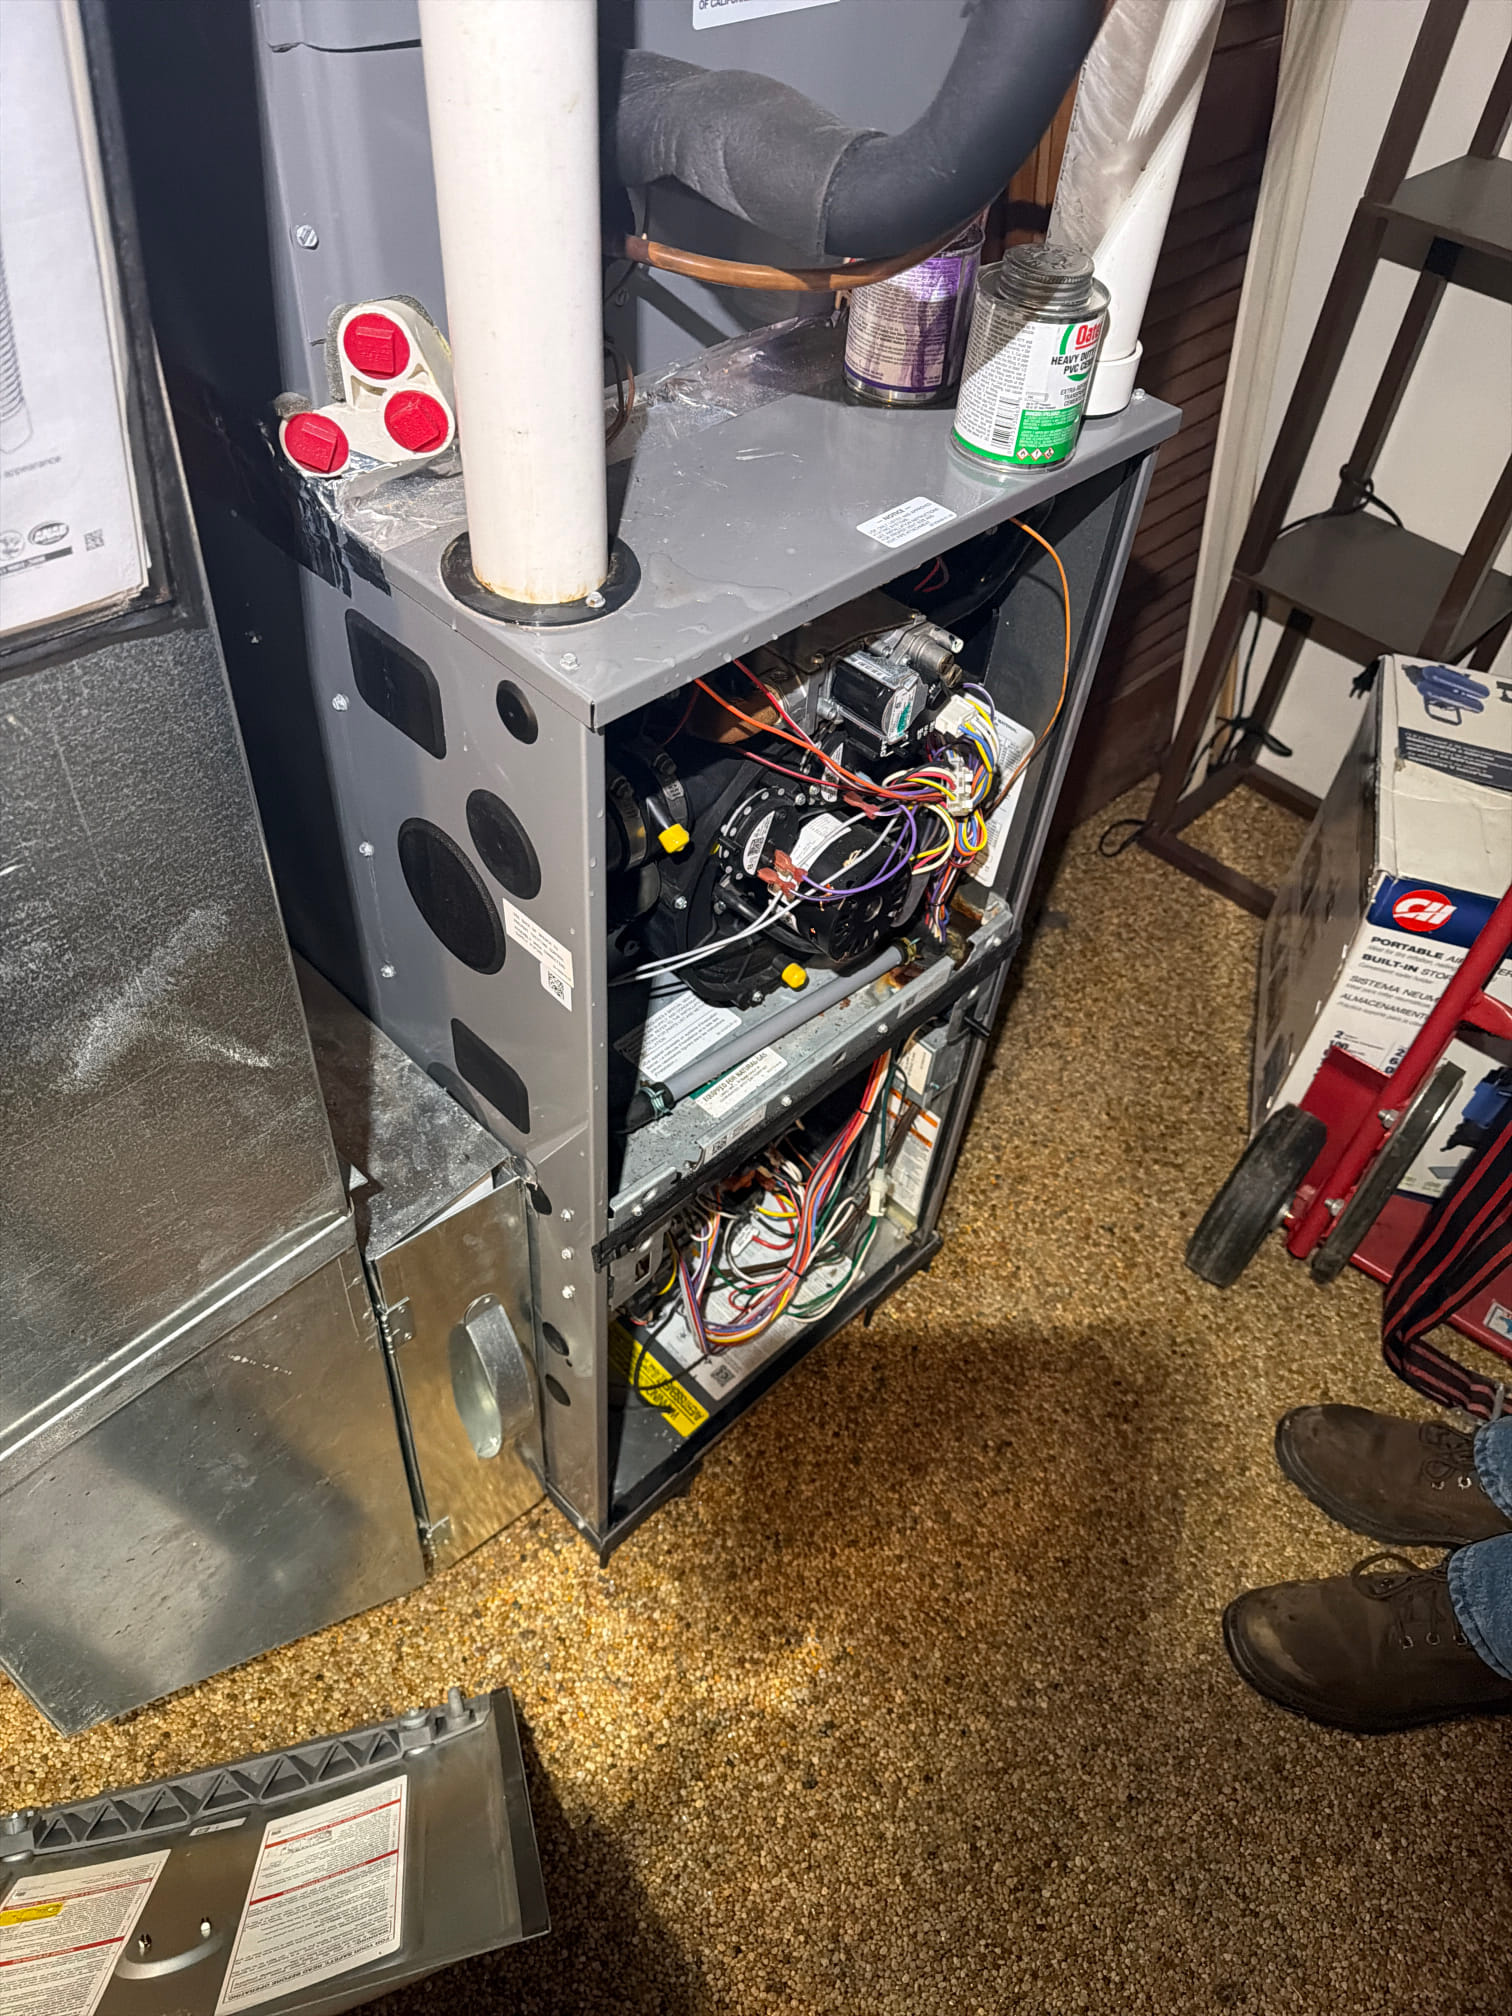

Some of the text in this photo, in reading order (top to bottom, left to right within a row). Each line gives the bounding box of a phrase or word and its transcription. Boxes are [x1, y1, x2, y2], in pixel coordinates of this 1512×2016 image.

[699, 0, 751, 10] OF CALIF
[1076, 321, 1102, 345] Oate
[1051, 354, 1080, 366] HEAVY
[1063, 364, 1079, 375] PVC
[1371, 936, 1445, 960] PORTABLE
[1362, 953, 1455, 980] BUILT-IN STOR
[1350, 975, 1400, 993] SISTEMA
[1334, 1030, 1344, 1039] 2
[725, 1076, 735, 1087] FOR
[735, 1060, 759, 1079] NATURAL
